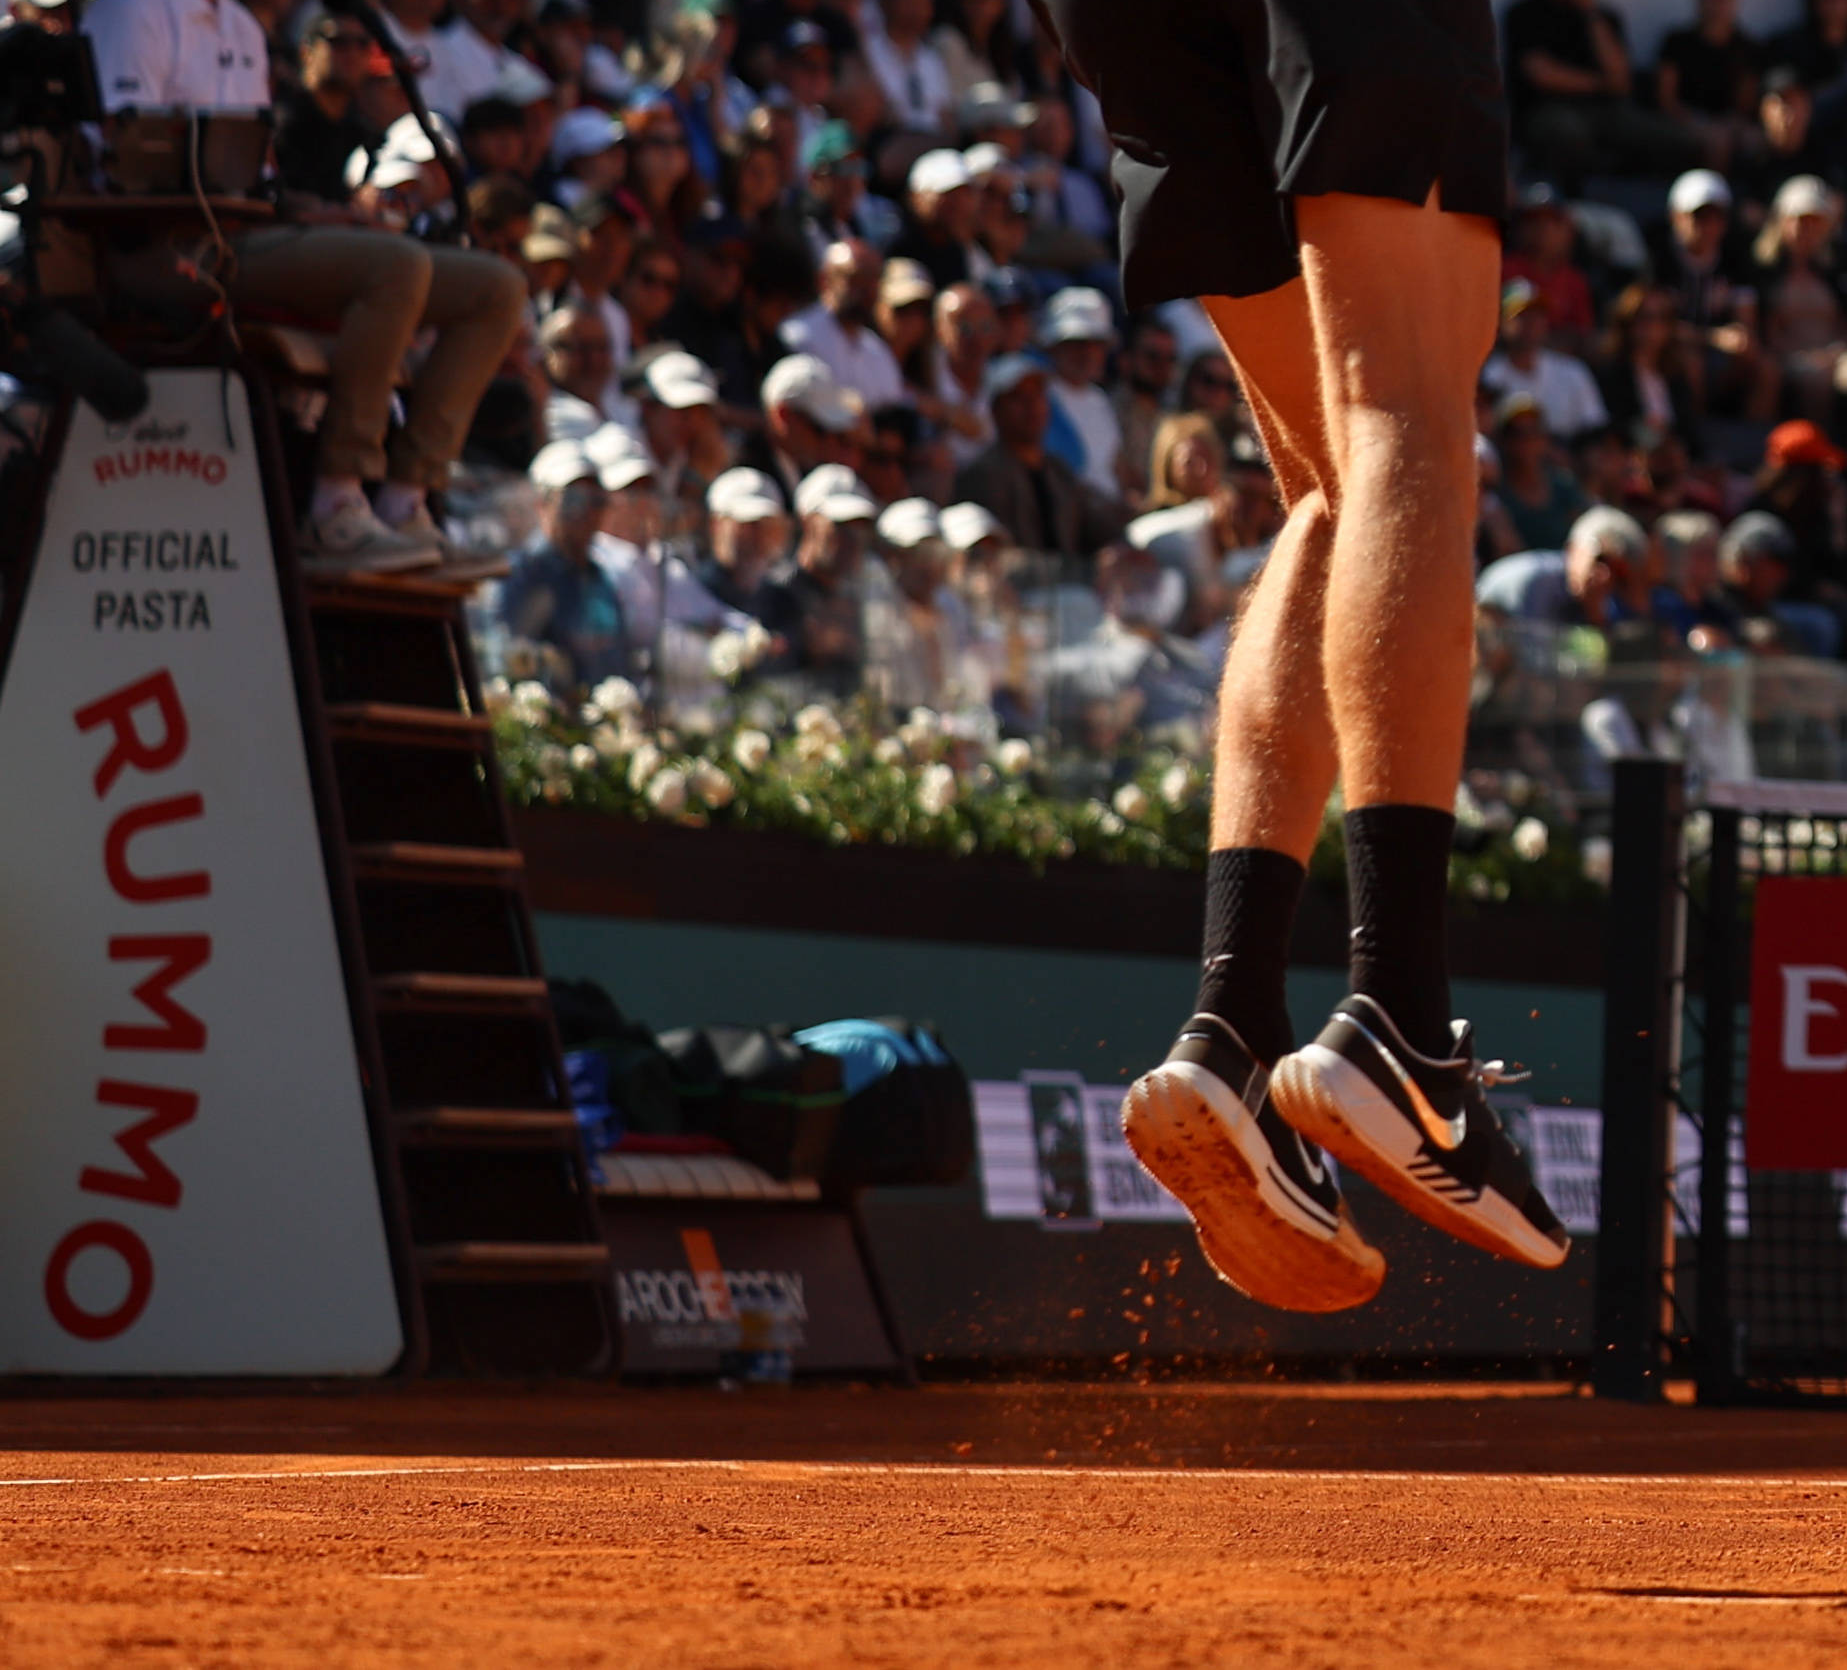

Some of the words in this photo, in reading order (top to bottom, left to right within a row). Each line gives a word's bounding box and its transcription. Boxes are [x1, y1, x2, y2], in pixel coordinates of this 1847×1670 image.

[93, 445, 227, 486] RUMMO
[73, 530, 238, 572] OFFICIAL
[94, 590, 211, 631] PASTA
[44, 667, 213, 1341] RUMMO
